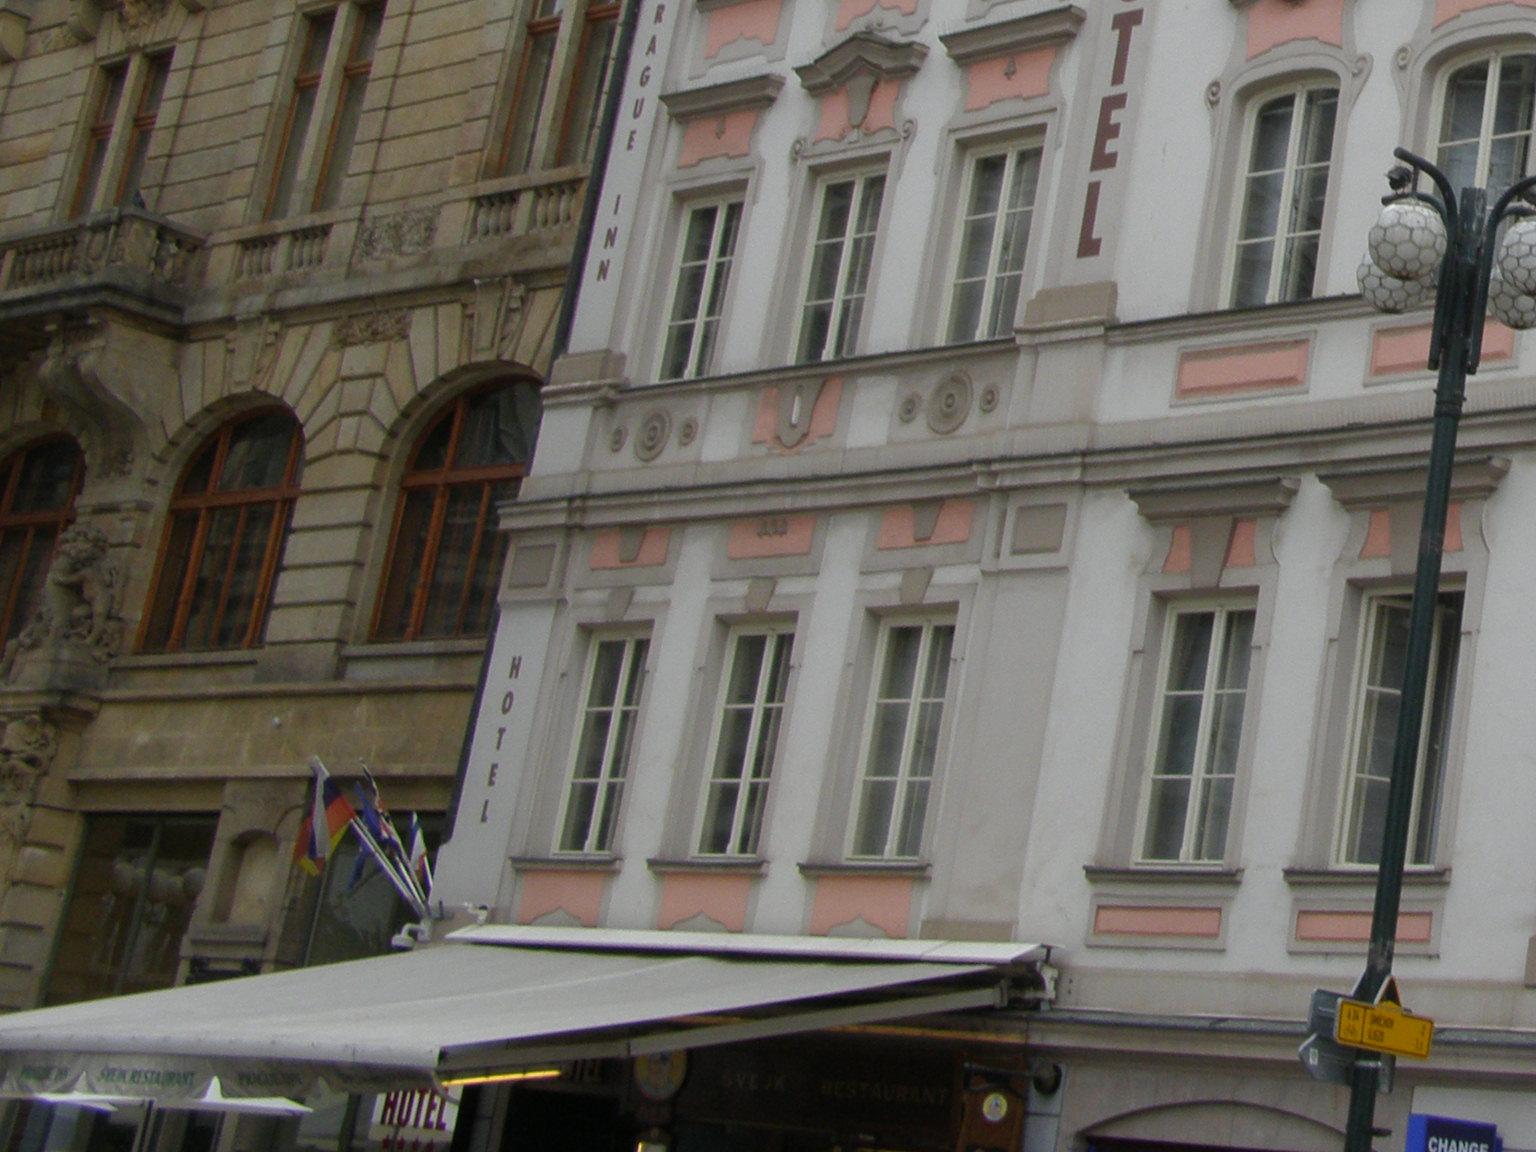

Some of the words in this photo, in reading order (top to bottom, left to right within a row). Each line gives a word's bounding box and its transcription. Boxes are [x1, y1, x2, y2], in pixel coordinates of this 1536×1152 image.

[596, 194, 621, 283] INN
[480, 655, 522, 823] HOTEL
[381, 1085, 449, 1131] HOTEL
[1427, 1135, 1489, 1152] CHANGE
